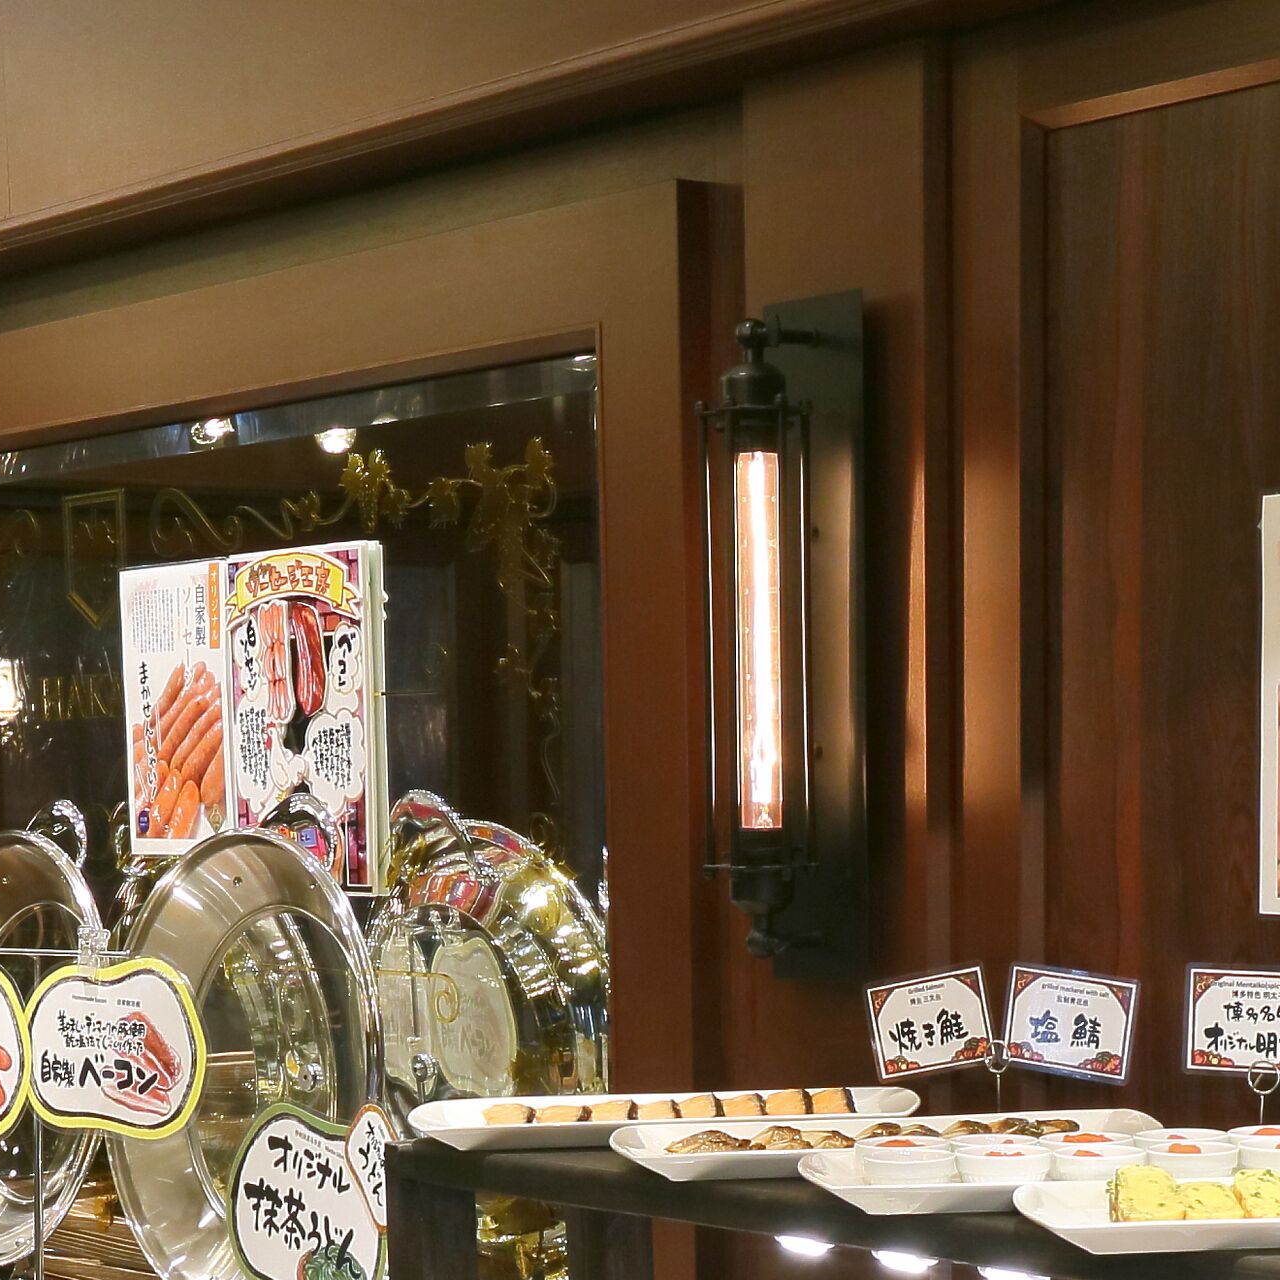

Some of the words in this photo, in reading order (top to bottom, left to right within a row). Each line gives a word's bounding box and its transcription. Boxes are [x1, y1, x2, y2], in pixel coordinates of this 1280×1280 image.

[194, 584, 207, 646] 自家製
[210, 569, 219, 642] オリジナル
[337, 632, 356, 687] ベーコン
[138, 661, 159, 803] まかせんしゃい！
[907, 985, 925, 995] Grilled
[1041, 982, 1058, 992] grilled
[1086, 987, 1099, 996] with
[1100, 989, 1110, 999] salt
[1231, 990, 1261, 999] 博多特色
[889, 1008, 969, 1052] 焼き鮭
[41, 1049, 159, 1095] 自家製ベーコン
[268, 1135, 351, 1194] オリジナル
[244, 1177, 362, 1280] 抹茶うどん
